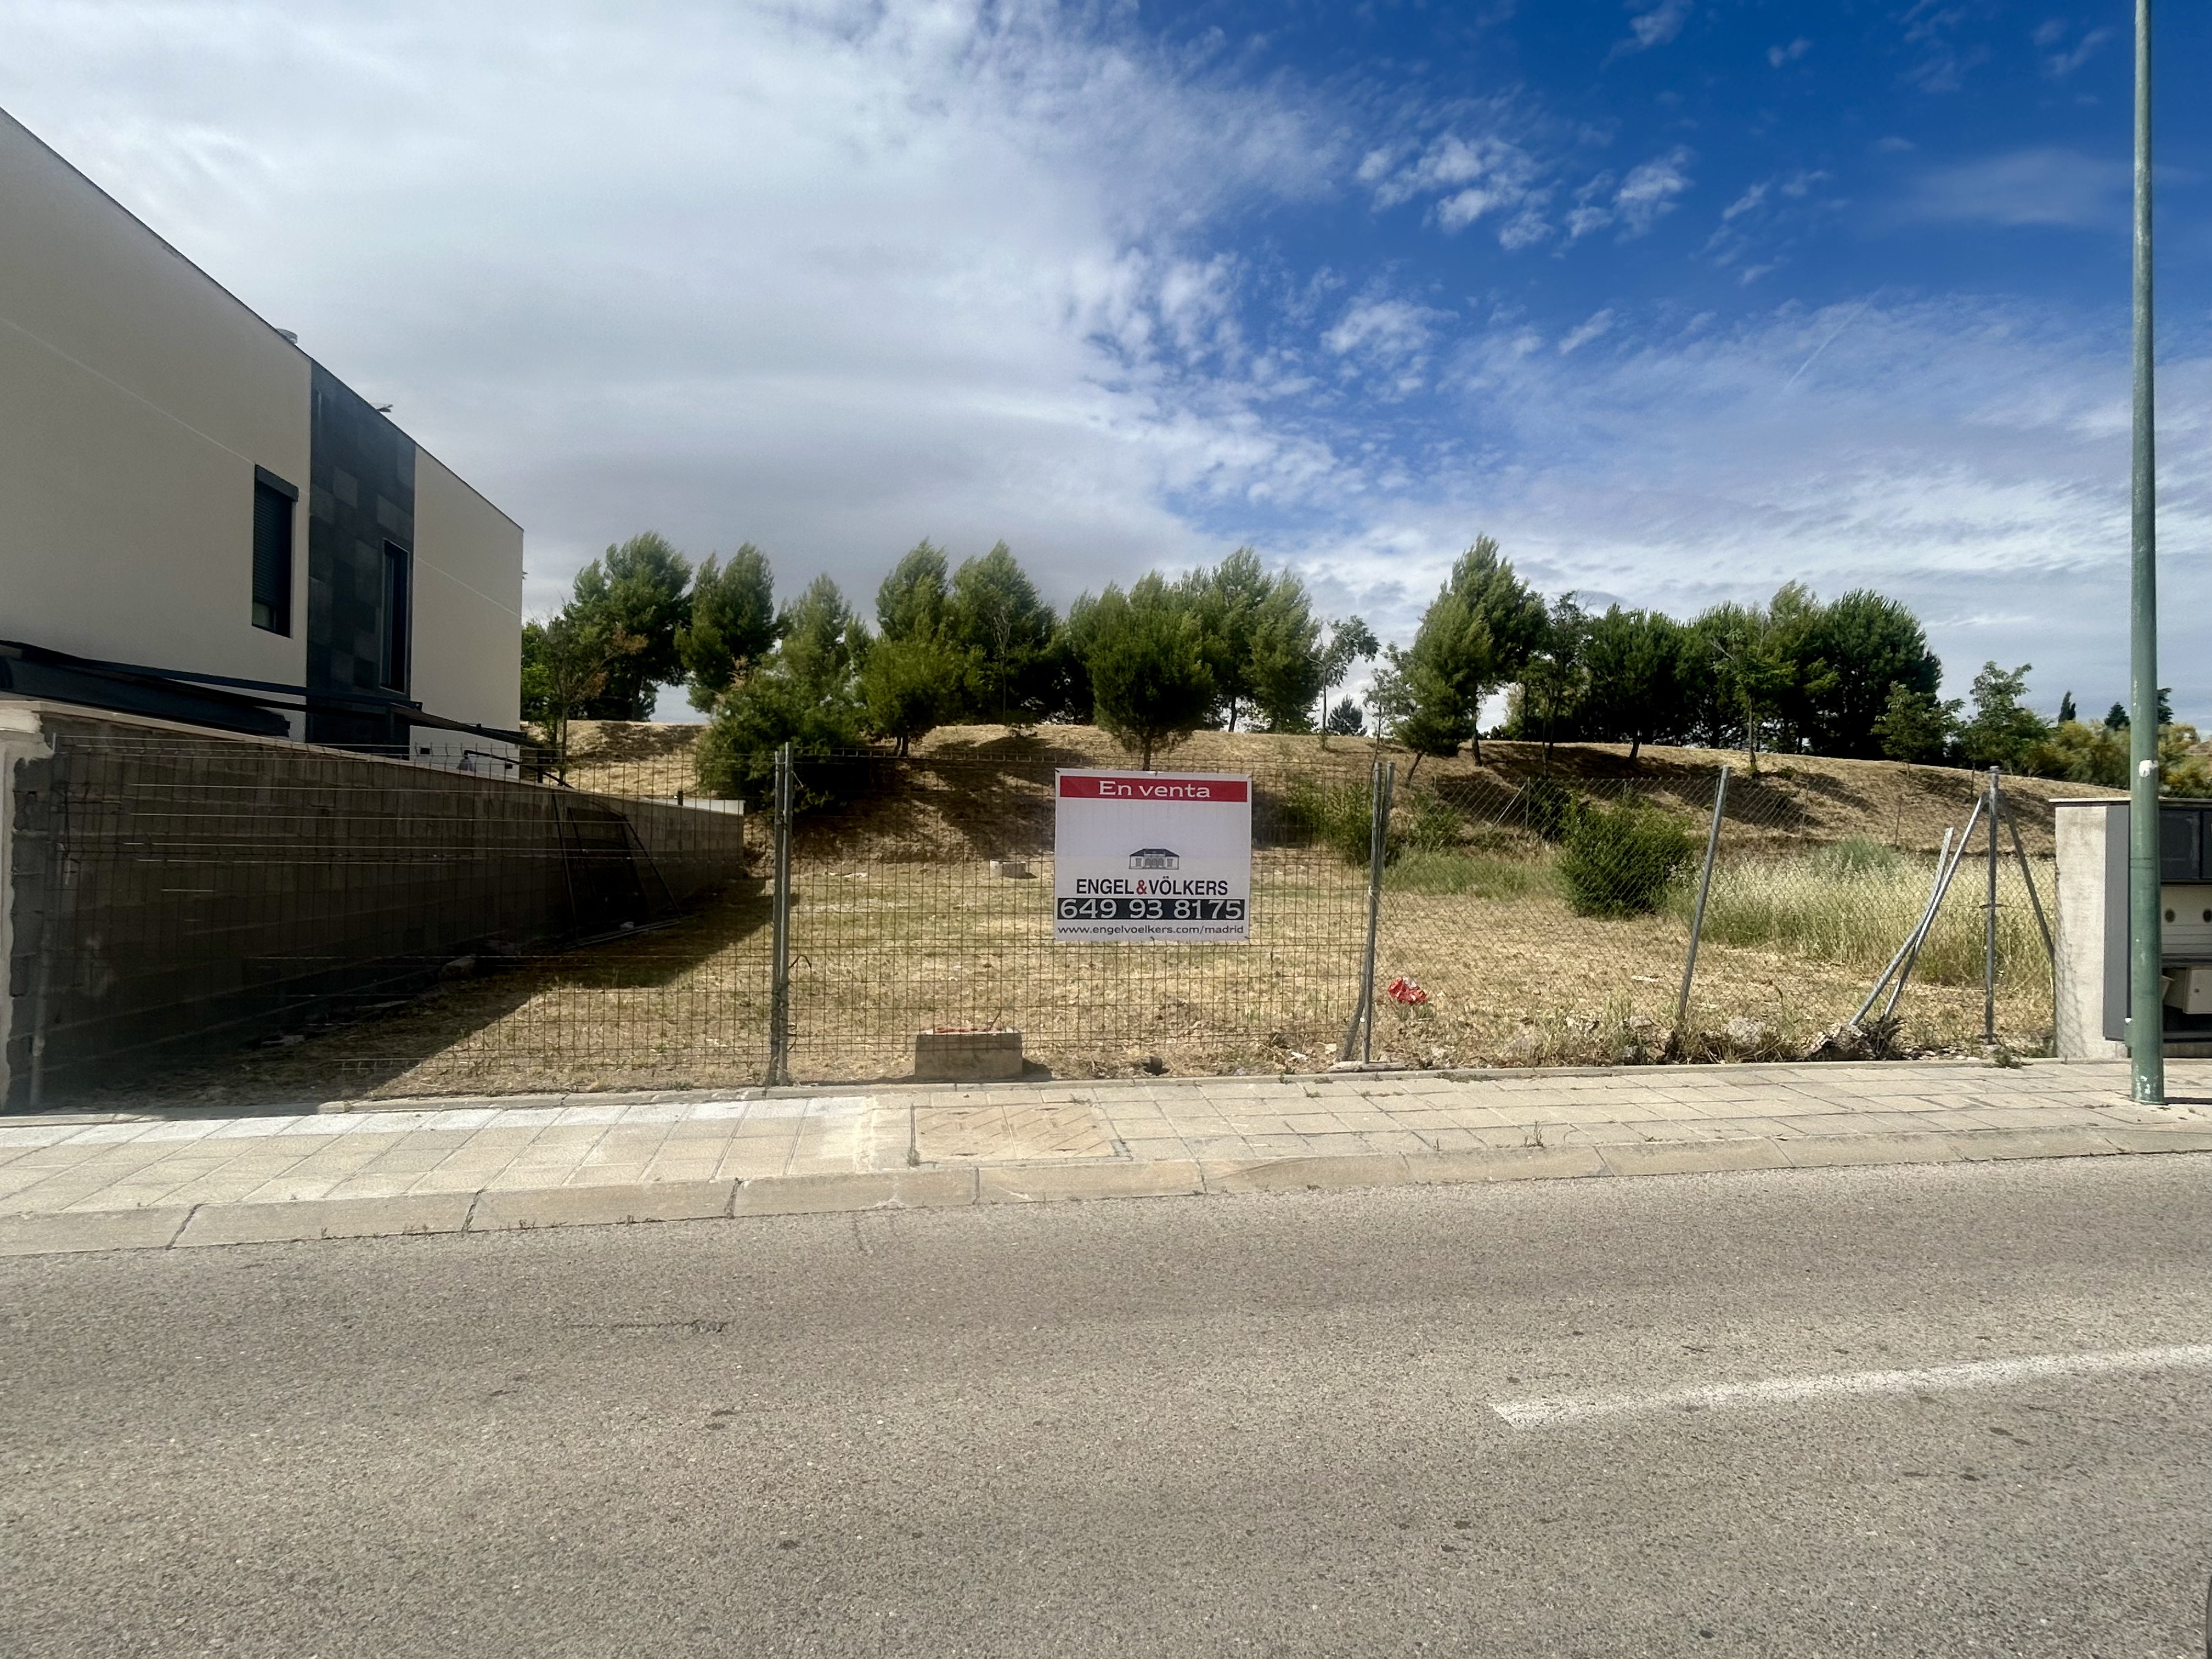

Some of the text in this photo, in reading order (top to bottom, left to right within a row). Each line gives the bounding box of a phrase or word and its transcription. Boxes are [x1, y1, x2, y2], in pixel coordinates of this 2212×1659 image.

[1099, 781, 1210, 798] En venta
[1060, 899, 1242, 919] 649 93 8175
[1058, 926, 1244, 935] www.engelvoelkers.com/madrid
